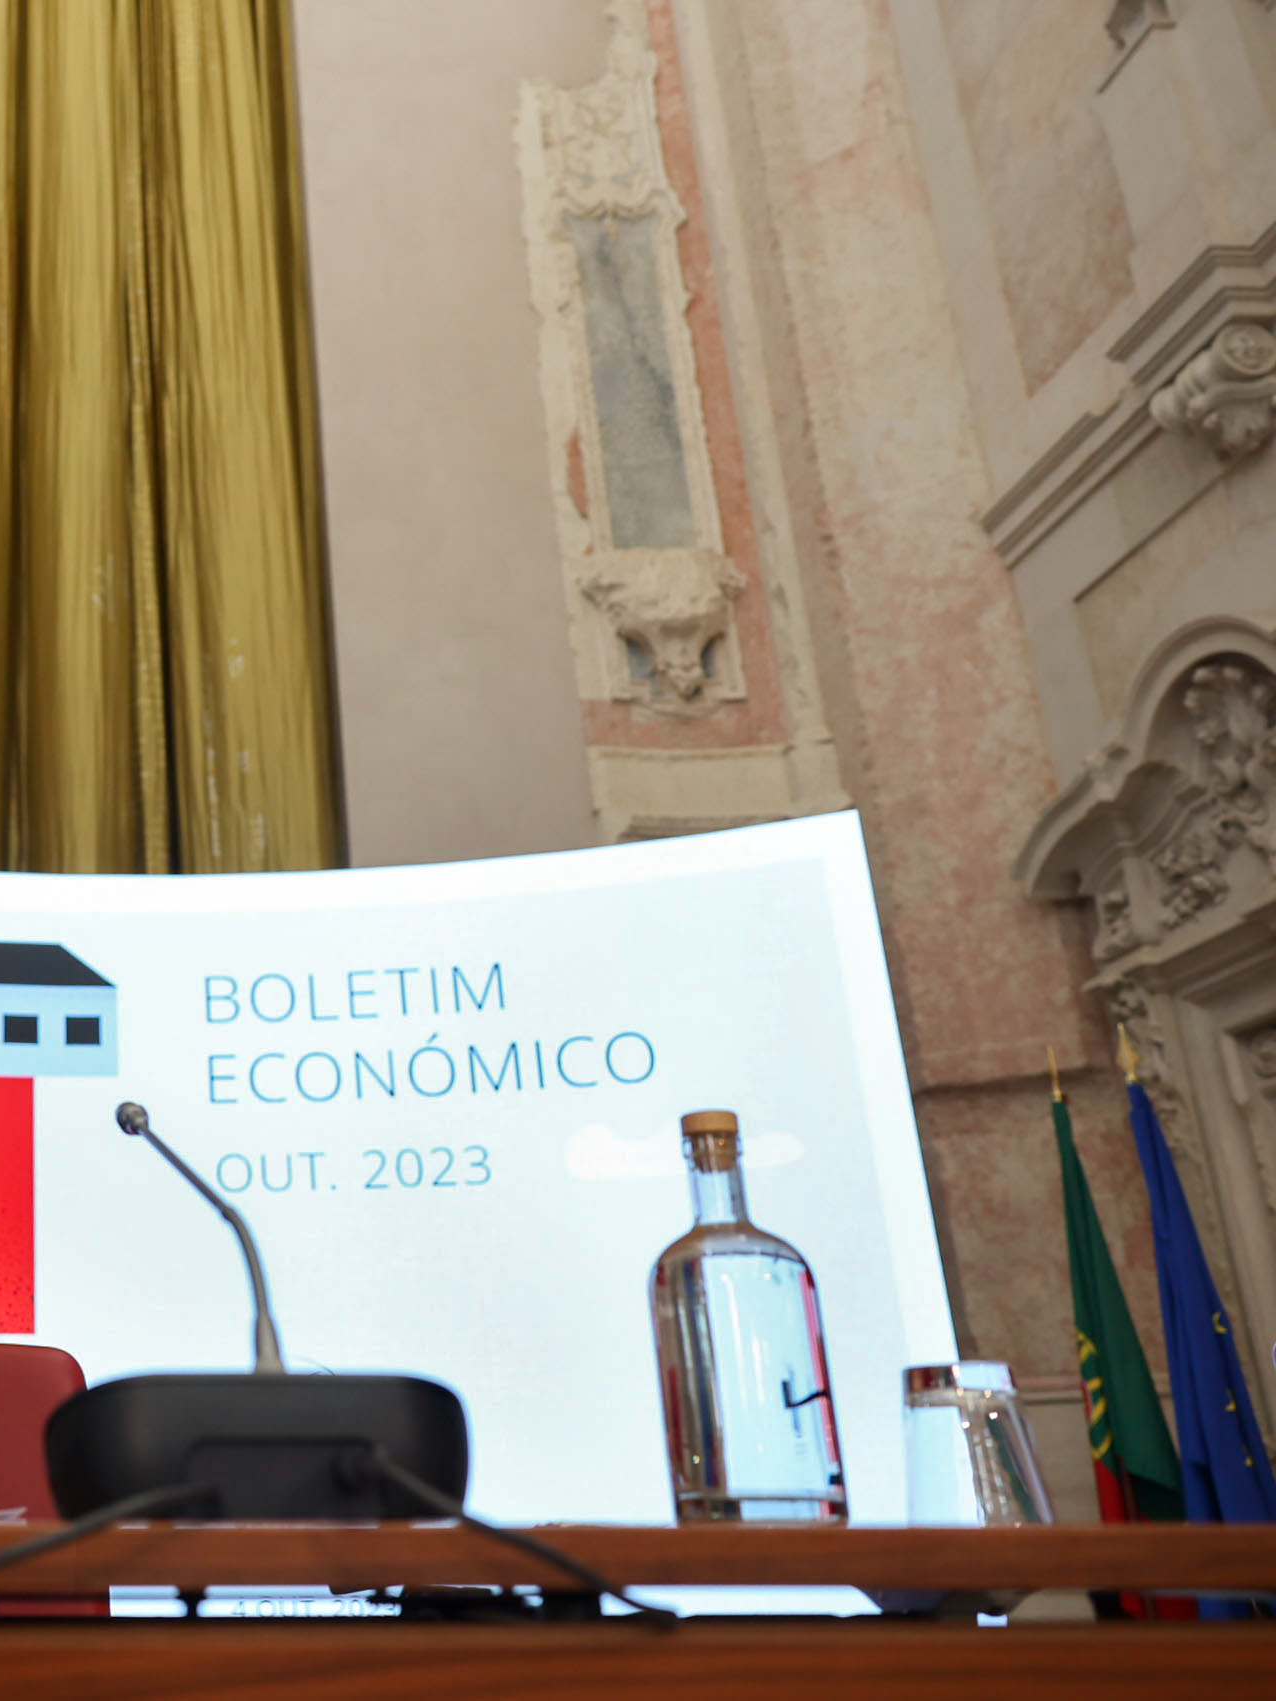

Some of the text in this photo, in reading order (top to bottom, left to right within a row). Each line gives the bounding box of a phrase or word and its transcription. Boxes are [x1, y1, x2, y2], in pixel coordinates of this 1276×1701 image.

[204, 962, 506, 1024] BOLETIM
[207, 1031, 655, 1104] ECONÓMICO
[215, 1144, 492, 1193] OUT. 2023
